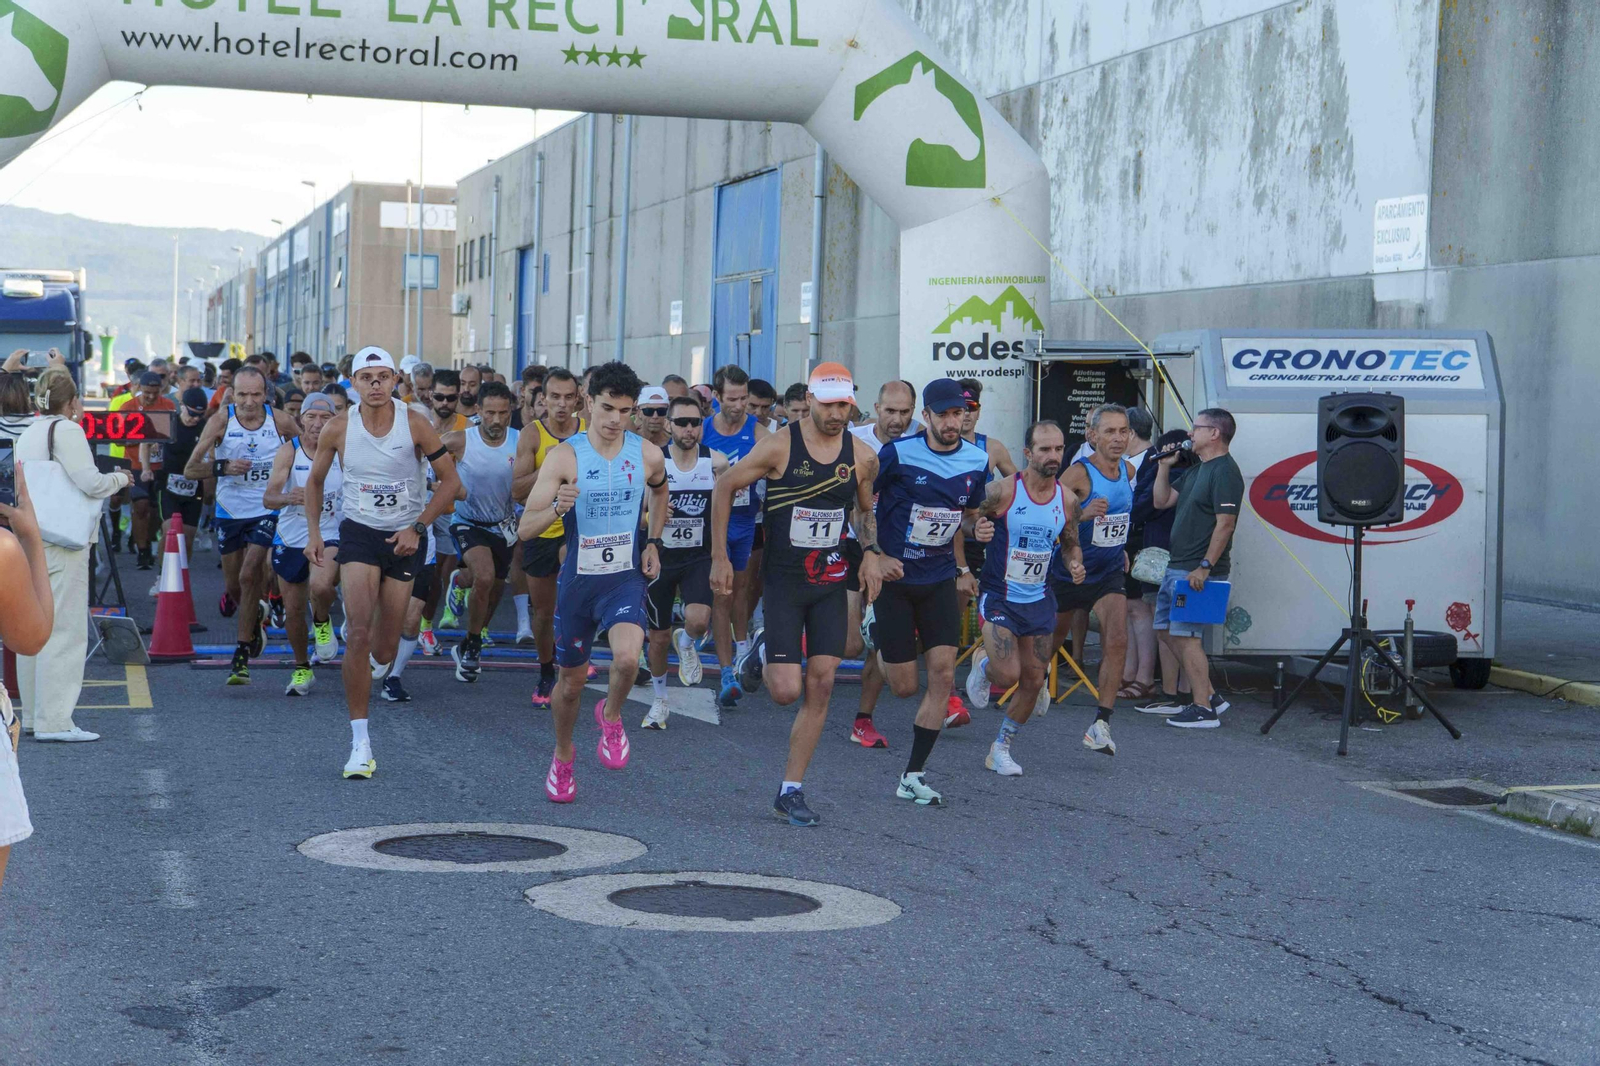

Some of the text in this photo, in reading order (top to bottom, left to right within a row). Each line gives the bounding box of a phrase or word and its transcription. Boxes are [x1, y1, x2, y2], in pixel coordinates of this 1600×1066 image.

[121, 22, 518, 71] www.hotelrectoral.com
[1377, 201, 1425, 220] APARCAMIENTO
[1377, 227, 1411, 245] EXCLUSIVO
[932, 332, 1025, 361] rodes
[1231, 348, 1471, 371] CRONOTEC
[1248, 373, 1460, 382] CRONOMETRAJE ELECTRÓNICO
[244, 470, 270, 481] 155
[374, 494, 397, 507] 23
[672, 528, 693, 539] 46
[809, 522, 831, 537] 11
[927, 522, 952, 536] 27
[1102, 524, 1126, 538] 152
[602, 547, 614, 563] 6
[1024, 562, 1043, 575] 70
